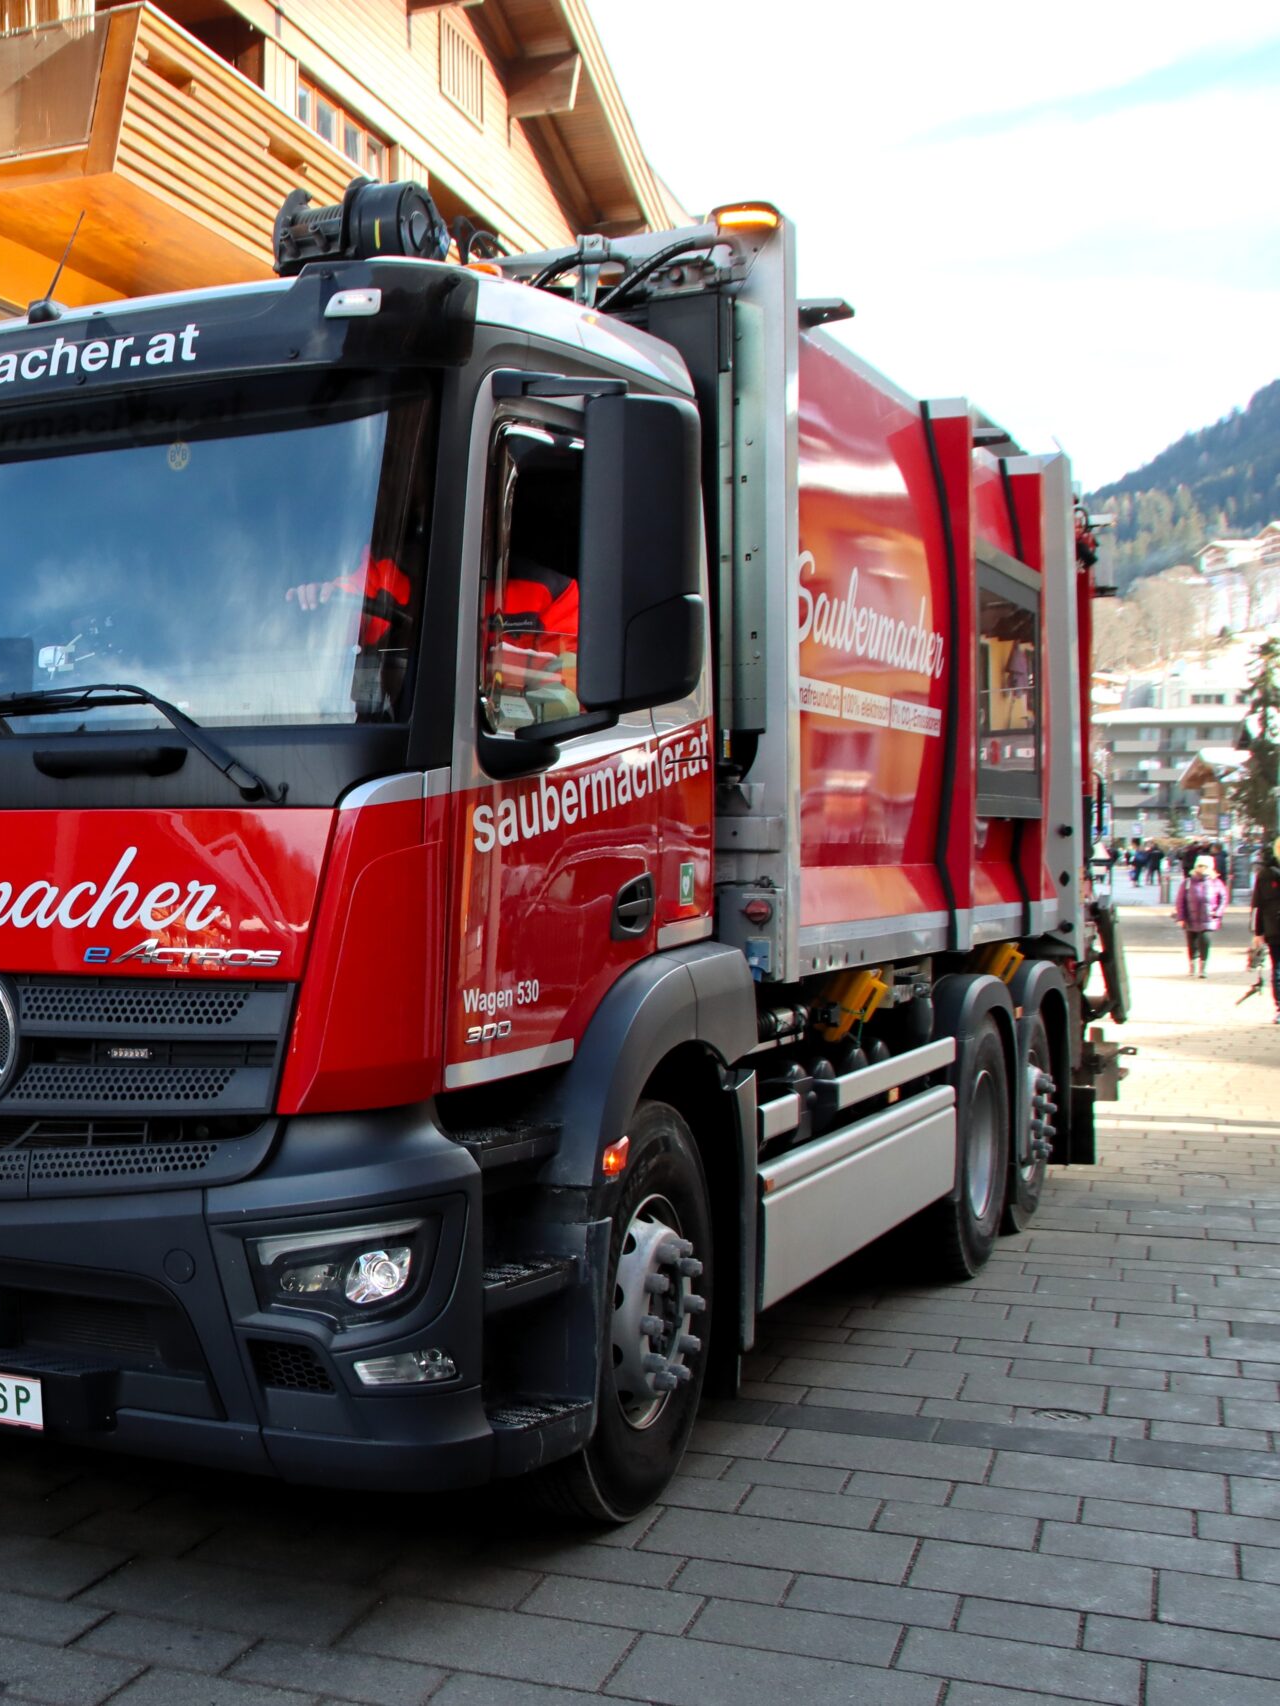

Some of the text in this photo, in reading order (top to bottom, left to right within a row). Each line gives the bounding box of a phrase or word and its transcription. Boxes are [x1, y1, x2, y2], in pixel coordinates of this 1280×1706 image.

[798, 550, 945, 679] Saubermacher
[472, 723, 709, 853] saubermacher.at
[463, 979, 539, 1017] Wagen 530
[464, 1020, 511, 1044] 300
